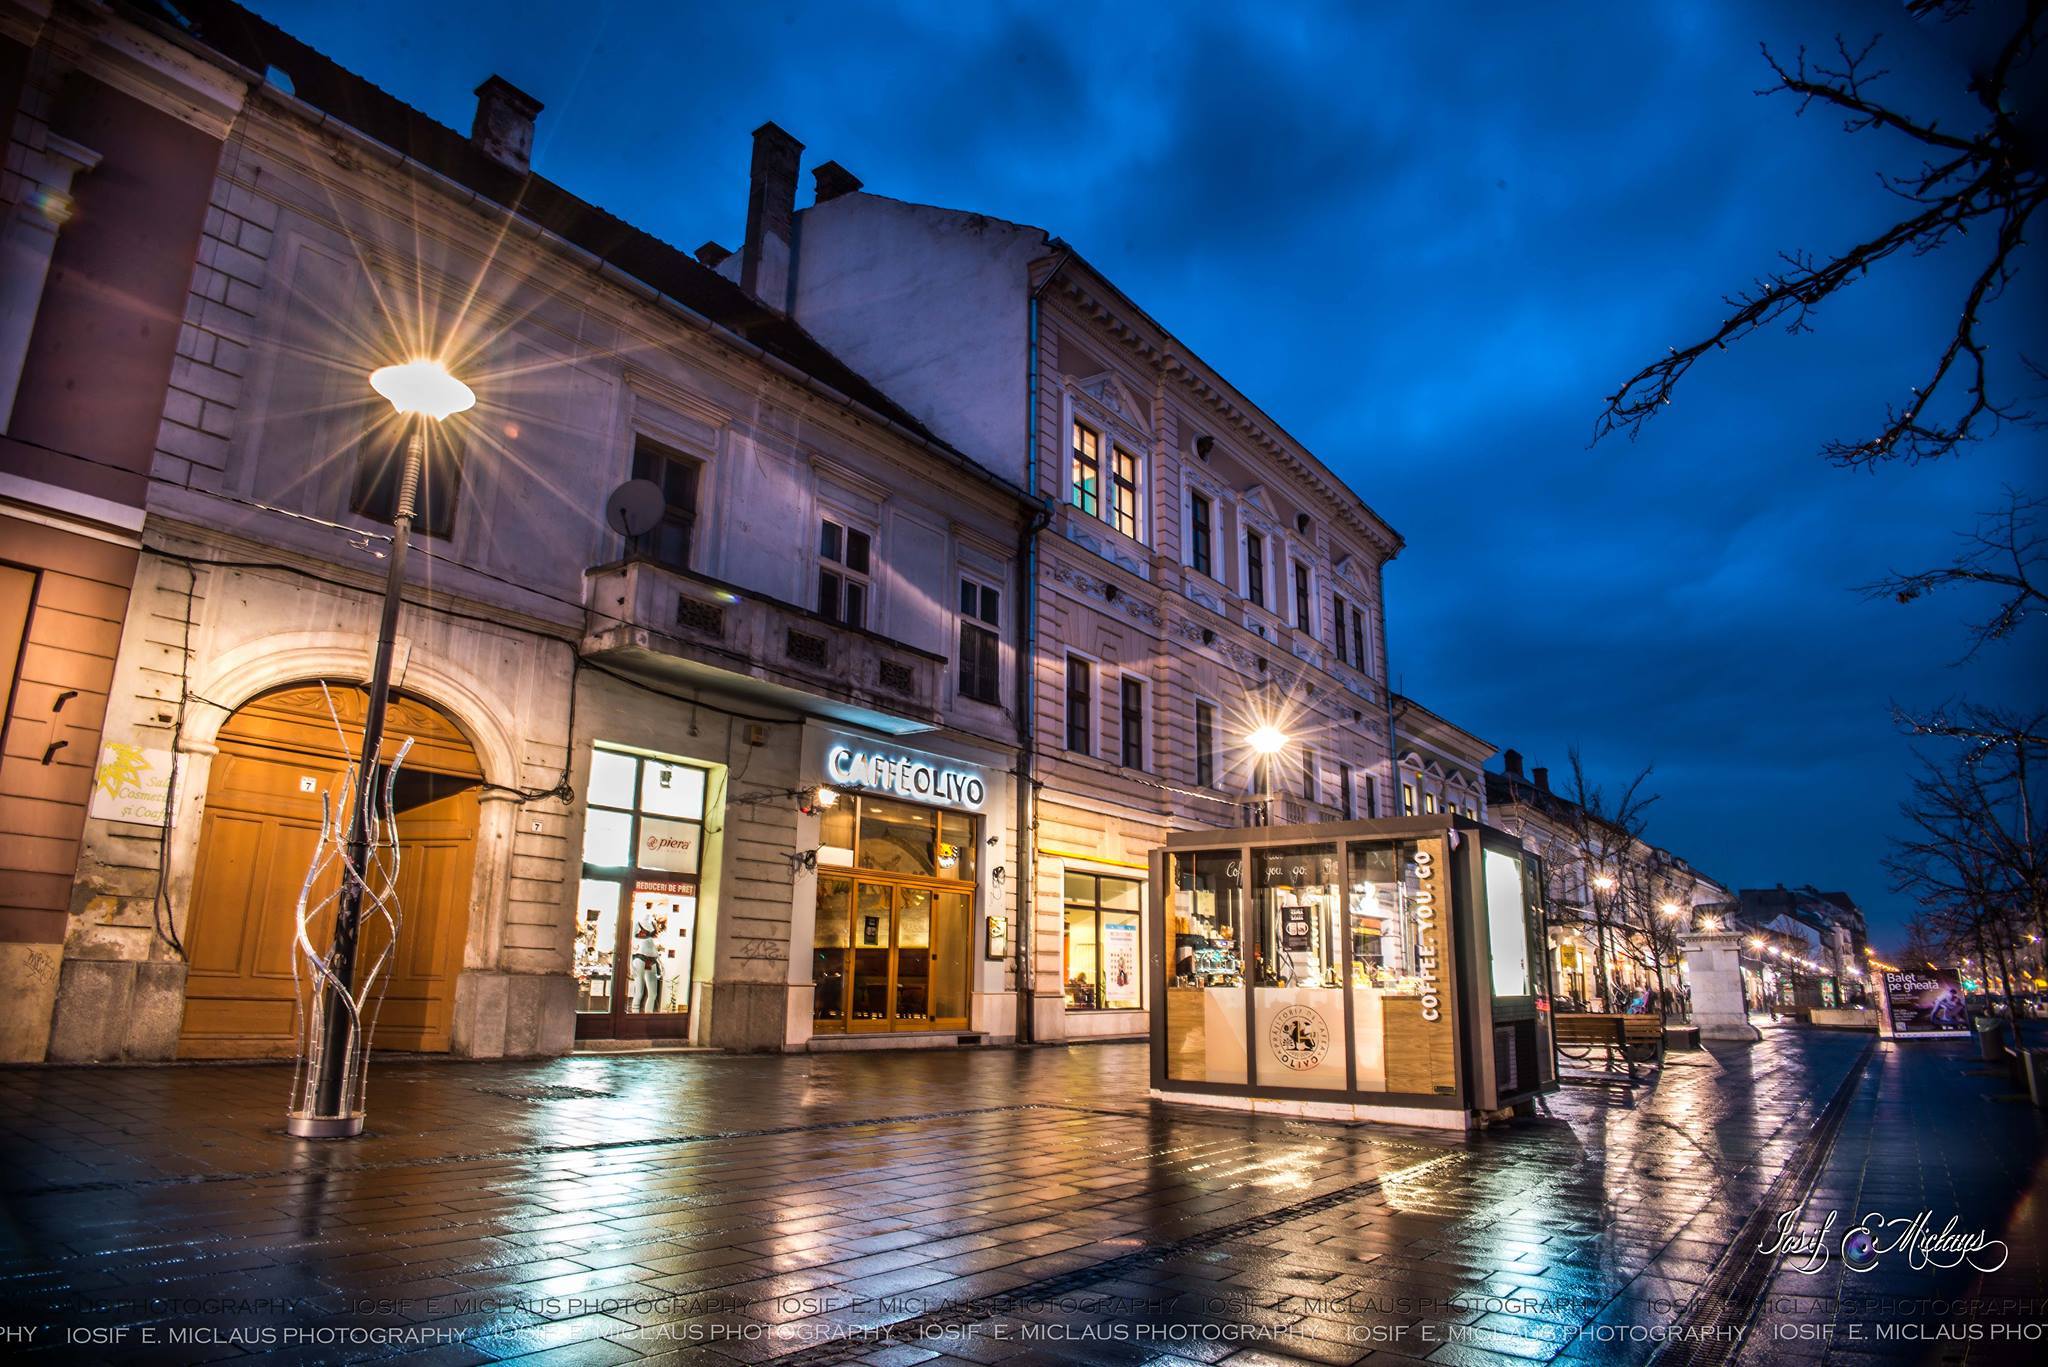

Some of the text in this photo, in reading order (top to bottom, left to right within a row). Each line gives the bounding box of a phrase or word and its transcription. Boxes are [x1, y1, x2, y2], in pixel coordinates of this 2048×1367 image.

[659, 837, 690, 850] piera
[1414, 851, 1432, 879] GO
[636, 881, 667, 892] REDUCERI
[668, 884, 677, 893] DE
[1886, 972, 1916, 983] Balet
[1888, 983, 1901, 993] pe
[1281, 1054, 1319, 1069] OLIVO
